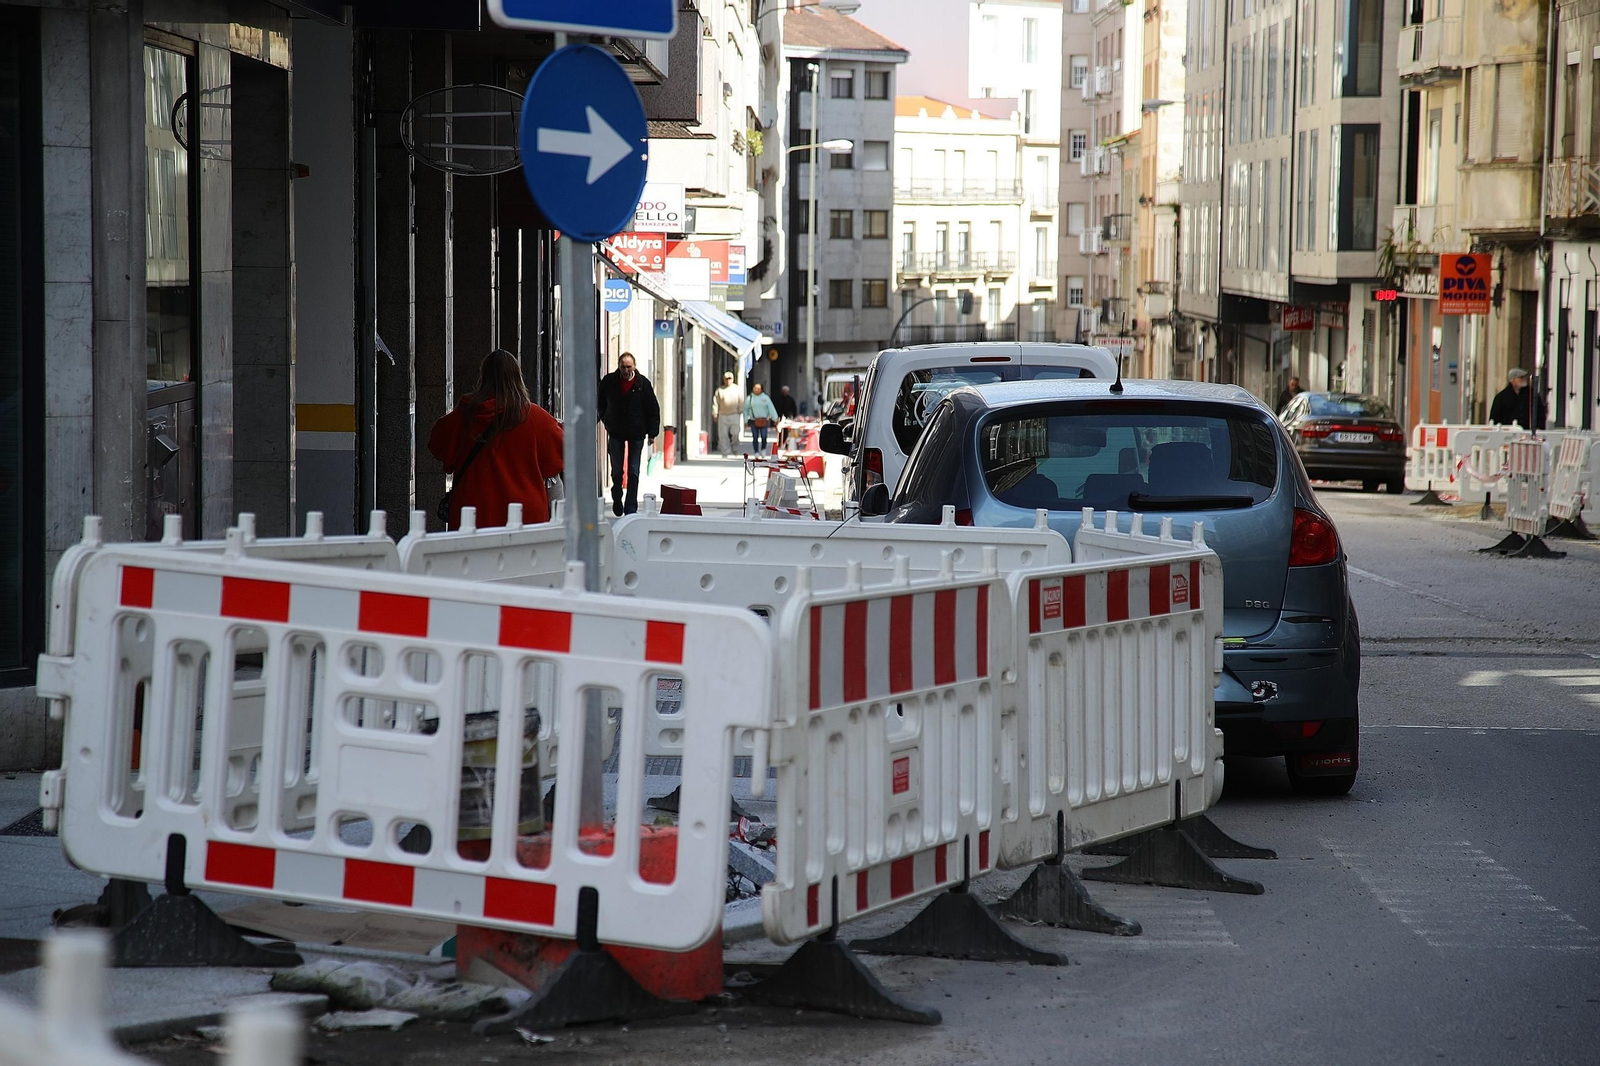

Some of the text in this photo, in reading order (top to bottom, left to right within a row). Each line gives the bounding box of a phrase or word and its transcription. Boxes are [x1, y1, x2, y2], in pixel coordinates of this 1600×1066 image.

[611, 234, 662, 253] Aldyra
[1443, 278, 1487, 291] PIVA
[604, 288, 629, 299] DIGI
[1443, 292, 1487, 301] MOTOR
[1245, 600, 1270, 609] DSG
